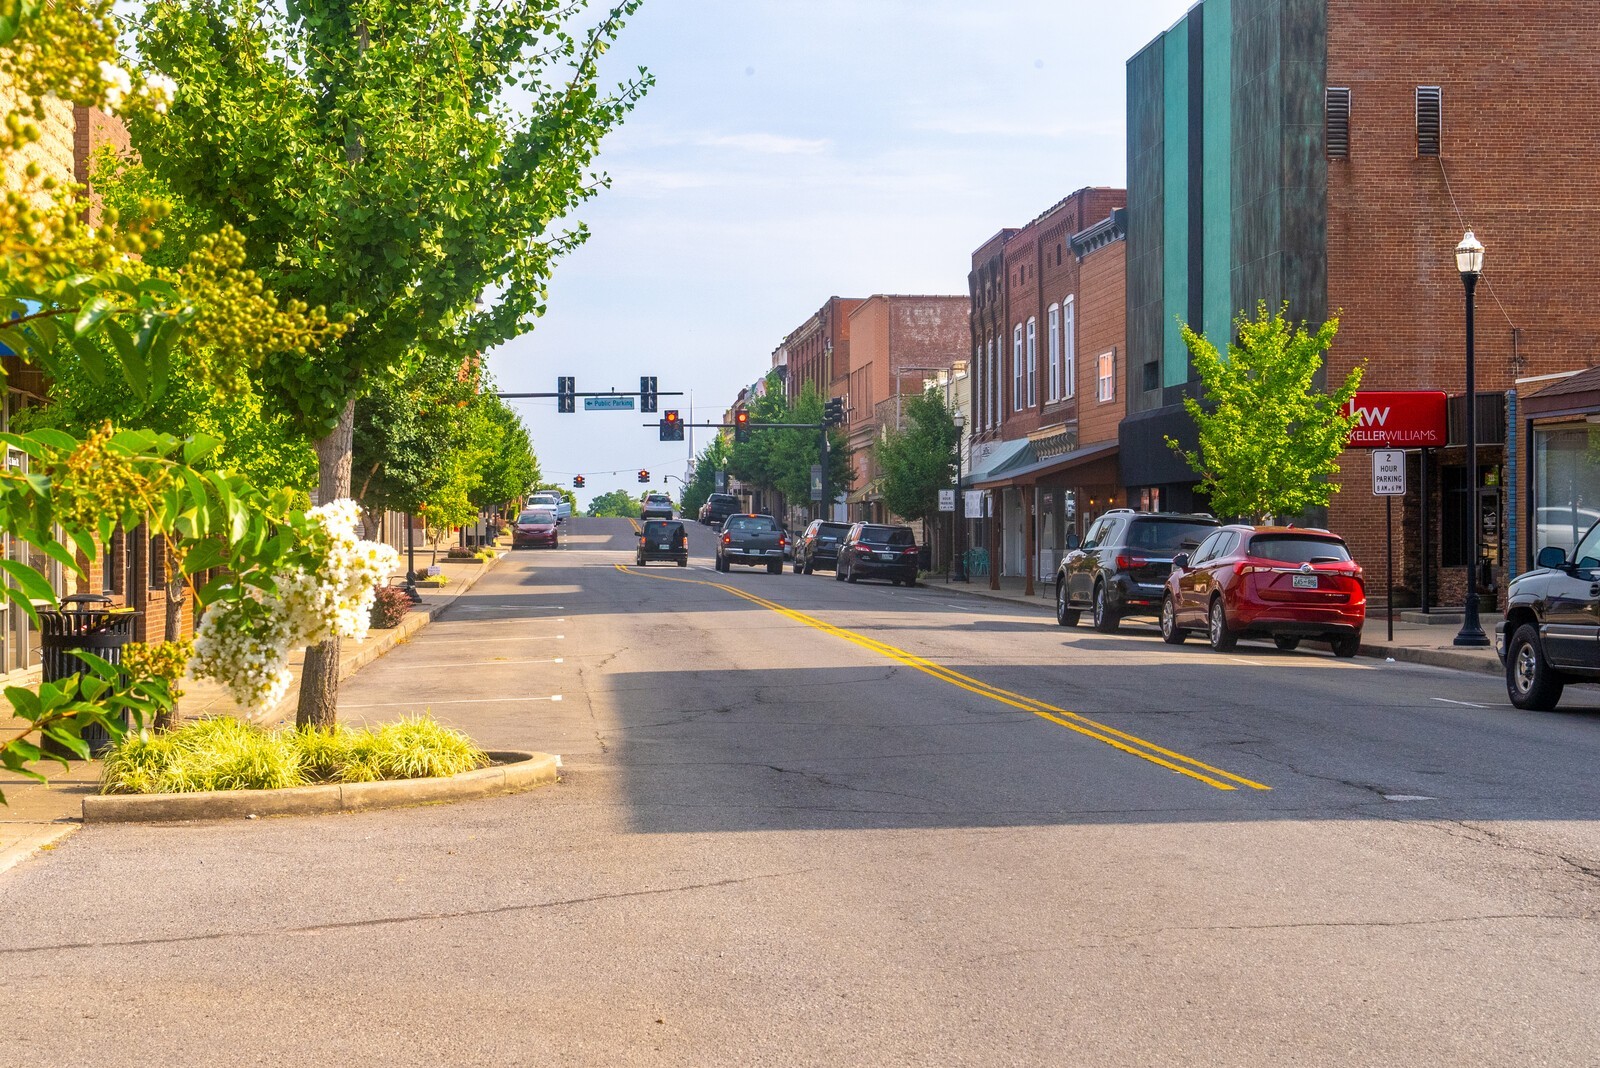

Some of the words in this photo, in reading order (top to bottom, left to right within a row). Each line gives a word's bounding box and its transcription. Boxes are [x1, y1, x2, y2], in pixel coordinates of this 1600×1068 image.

[613, 400, 633, 408] Parking
[1349, 398, 1390, 426] kw
[1386, 453, 1391, 462] 2
[1376, 475, 1402, 483] PARKING
